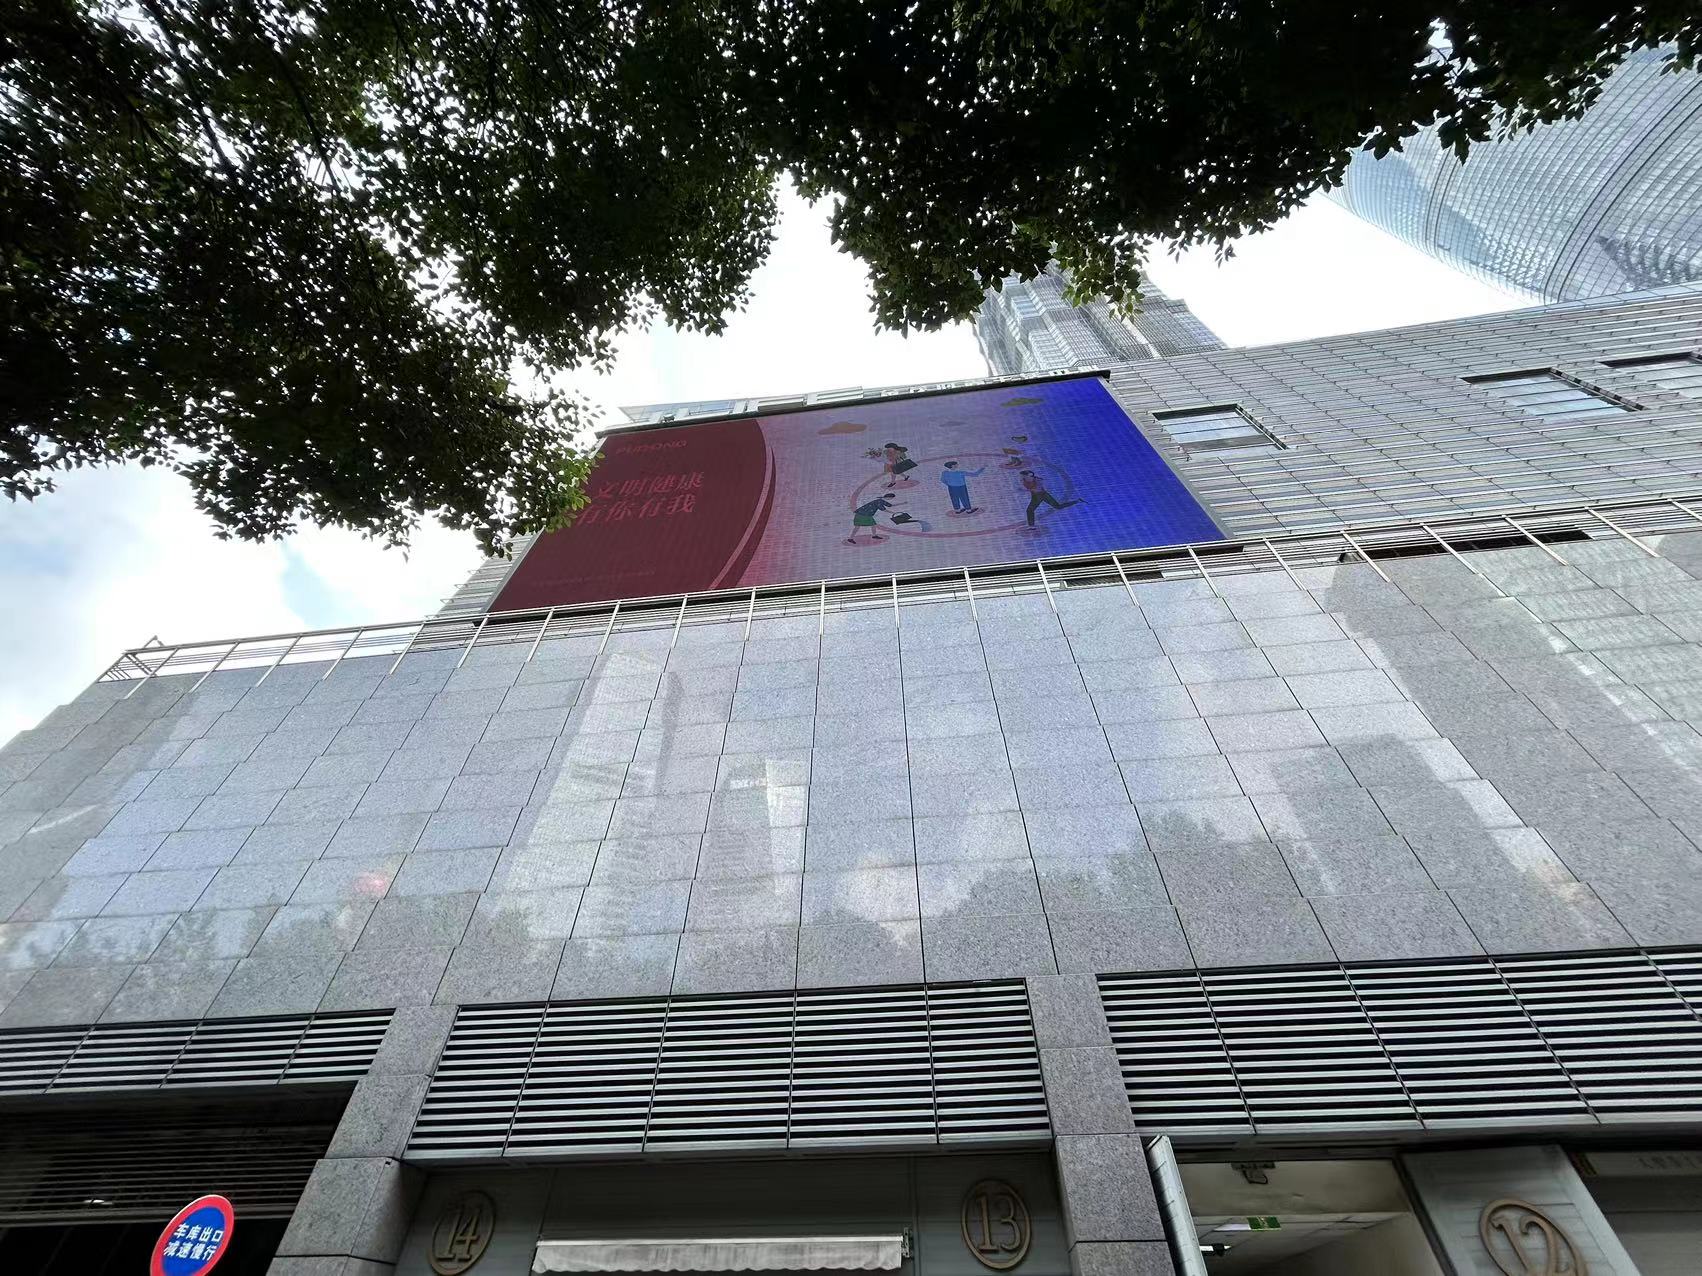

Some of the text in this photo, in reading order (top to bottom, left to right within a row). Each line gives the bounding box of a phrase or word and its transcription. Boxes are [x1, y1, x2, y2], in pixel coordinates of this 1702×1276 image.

[596, 472, 704, 498] 文明健康
[577, 495, 696, 524] 有你有我
[173, 1222, 224, 1243] 车库出口
[434, 1203, 481, 1262] 14
[976, 1191, 1022, 1253] 13
[163, 1241, 217, 1261] 减速慢行
[1489, 1212, 1571, 1276] 12
